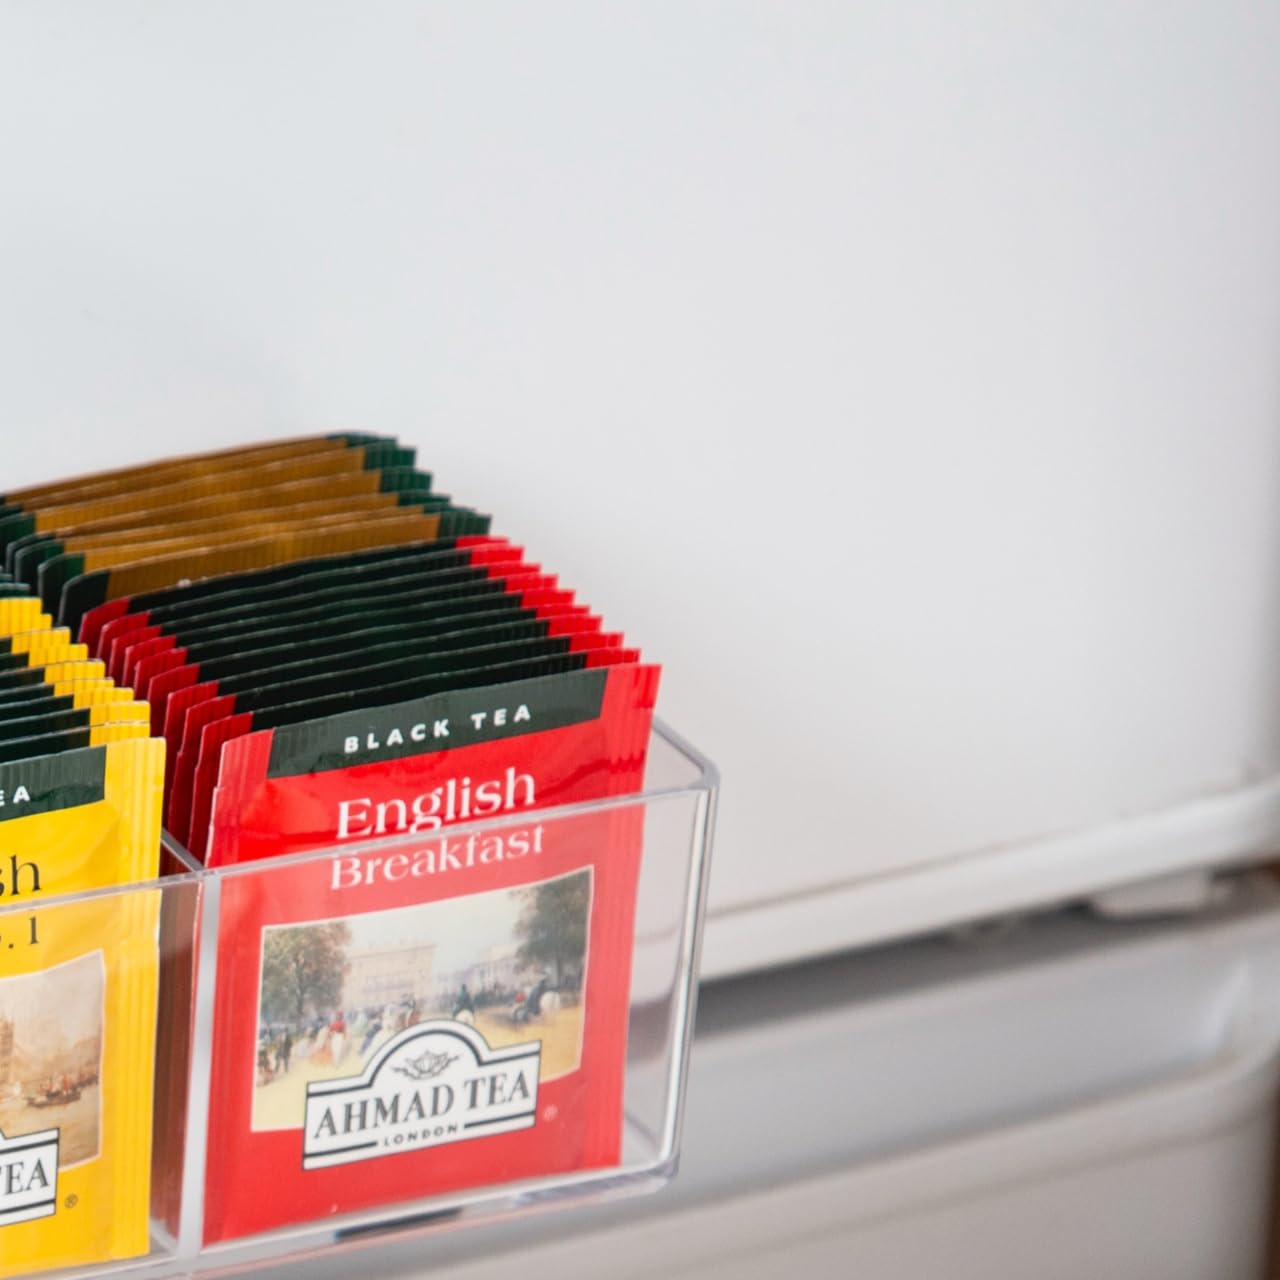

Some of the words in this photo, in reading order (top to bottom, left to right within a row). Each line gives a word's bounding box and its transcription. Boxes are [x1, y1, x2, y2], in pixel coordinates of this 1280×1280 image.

[343, 718, 450, 755] BLACK
[470, 704, 531, 731] TEA
[336, 766, 536, 839] English
[330, 824, 545, 890] Breakfast
[313, 1083, 455, 1140] AHMAD
[463, 1068, 530, 1111] TEA
[383, 1124, 458, 1147] LONDON
